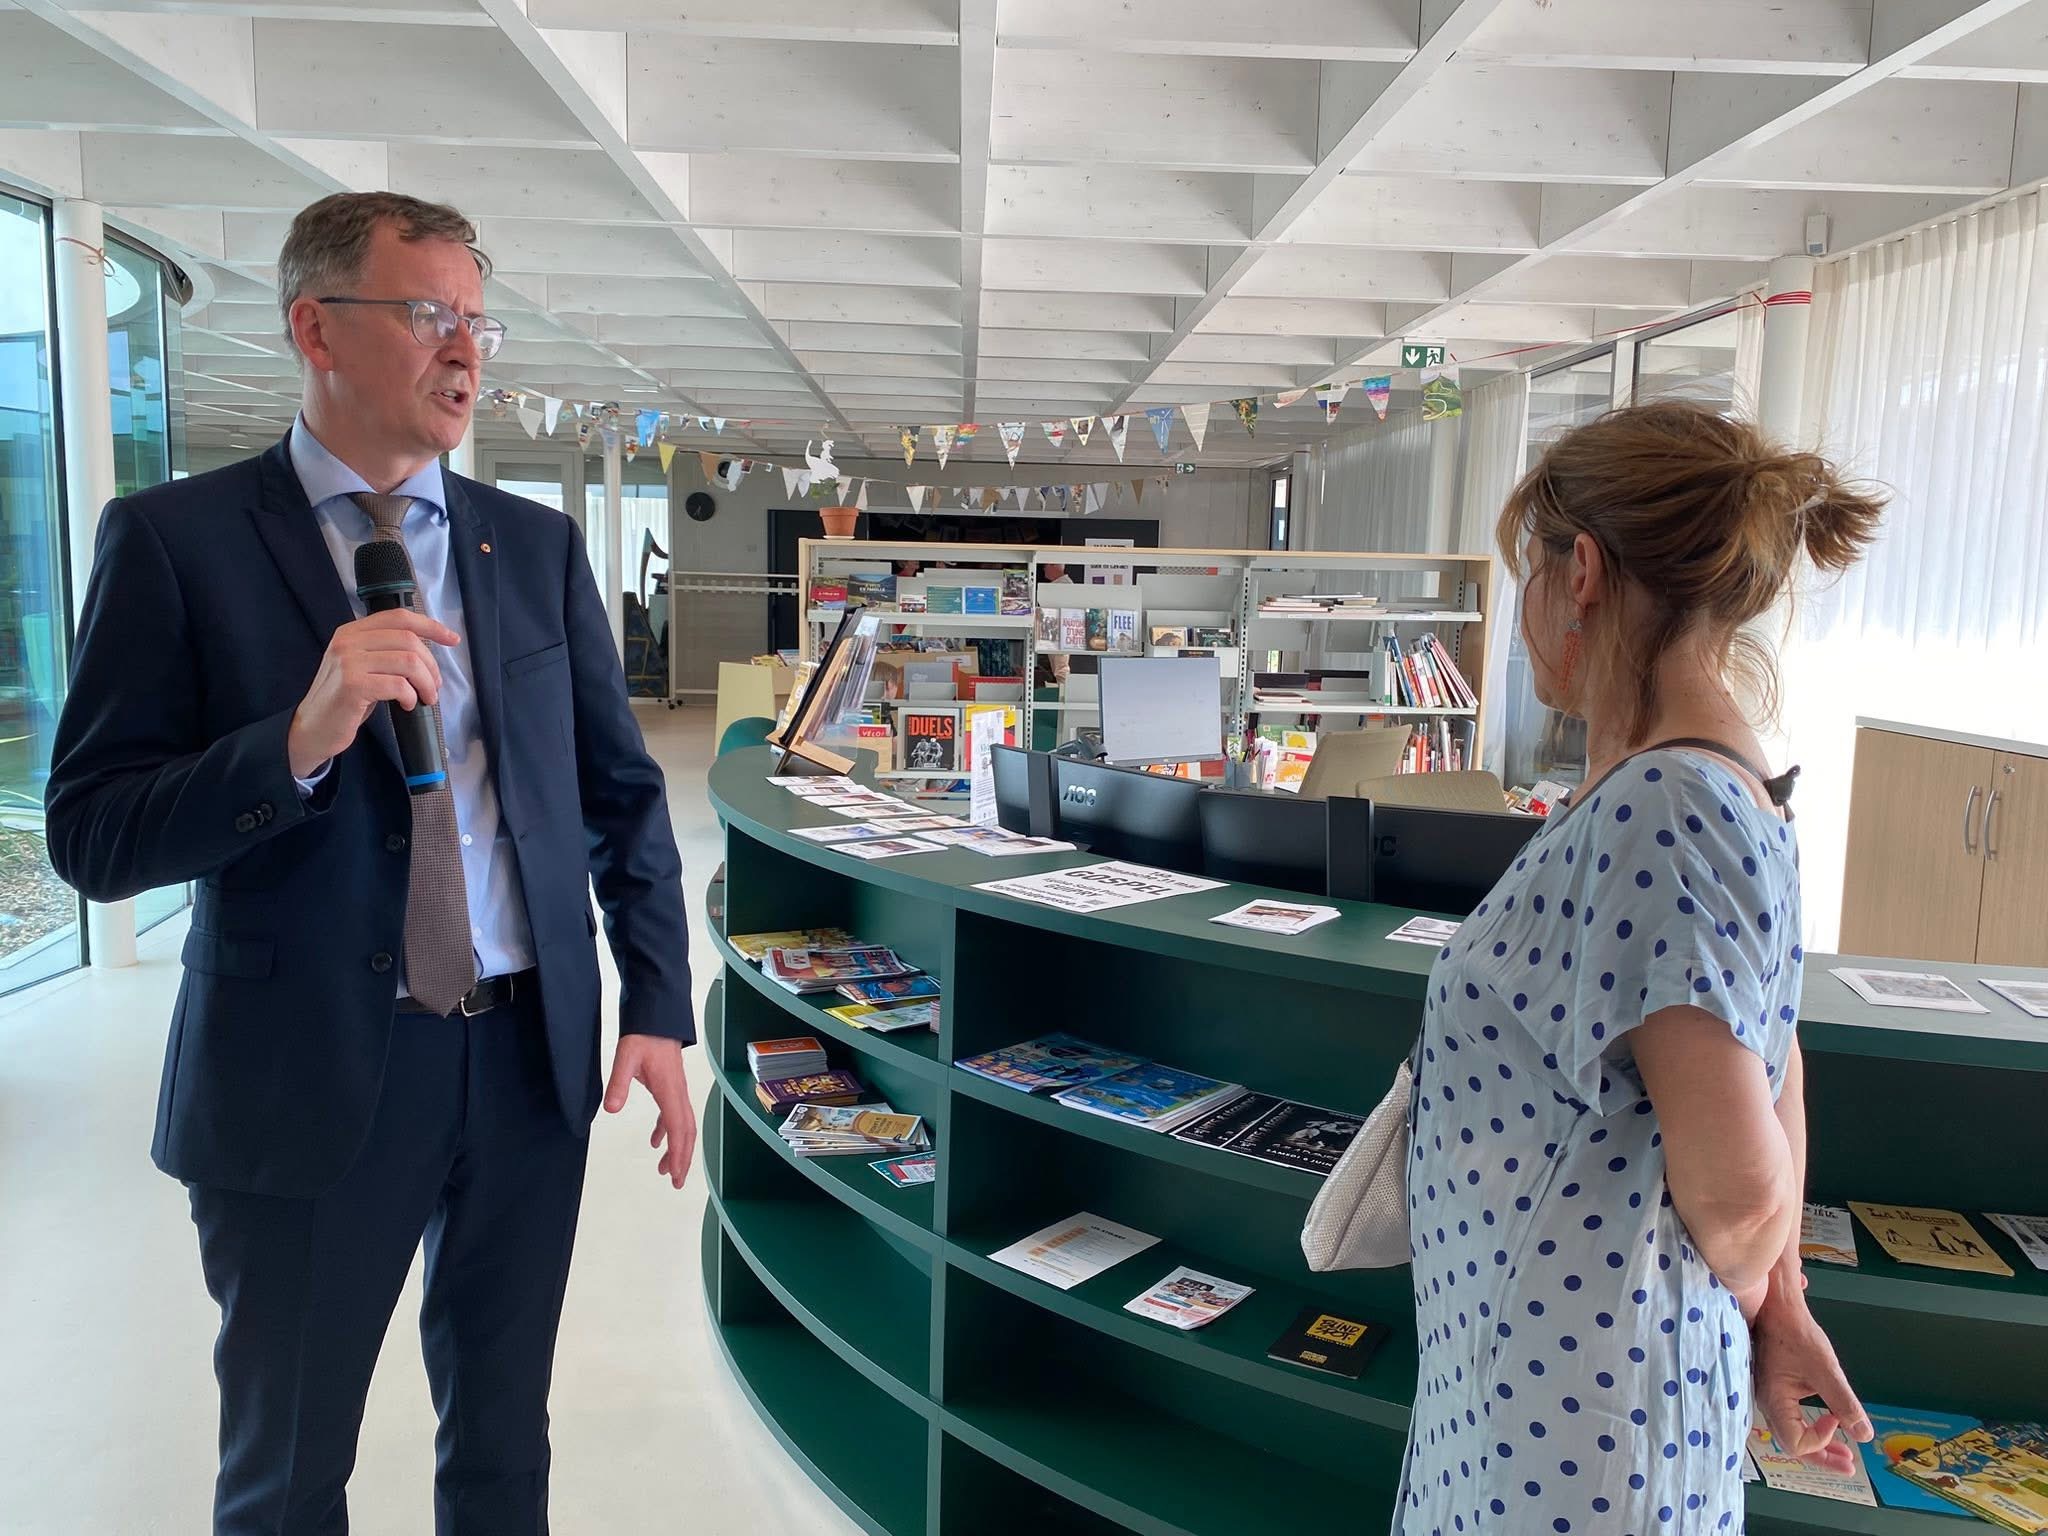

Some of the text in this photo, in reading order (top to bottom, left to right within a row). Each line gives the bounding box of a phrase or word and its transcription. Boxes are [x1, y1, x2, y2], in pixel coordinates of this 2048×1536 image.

[1114, 615, 1132, 630] FLEE
[911, 716, 953, 737] DUELS
[1063, 784, 1097, 807] AOC
[1065, 870, 1173, 896] GOSPEL
[1265, 1148, 1300, 1159] SAMEDI
[1310, 1158, 1334, 1167] JUIN
[1320, 1319, 1361, 1335] BLIND
